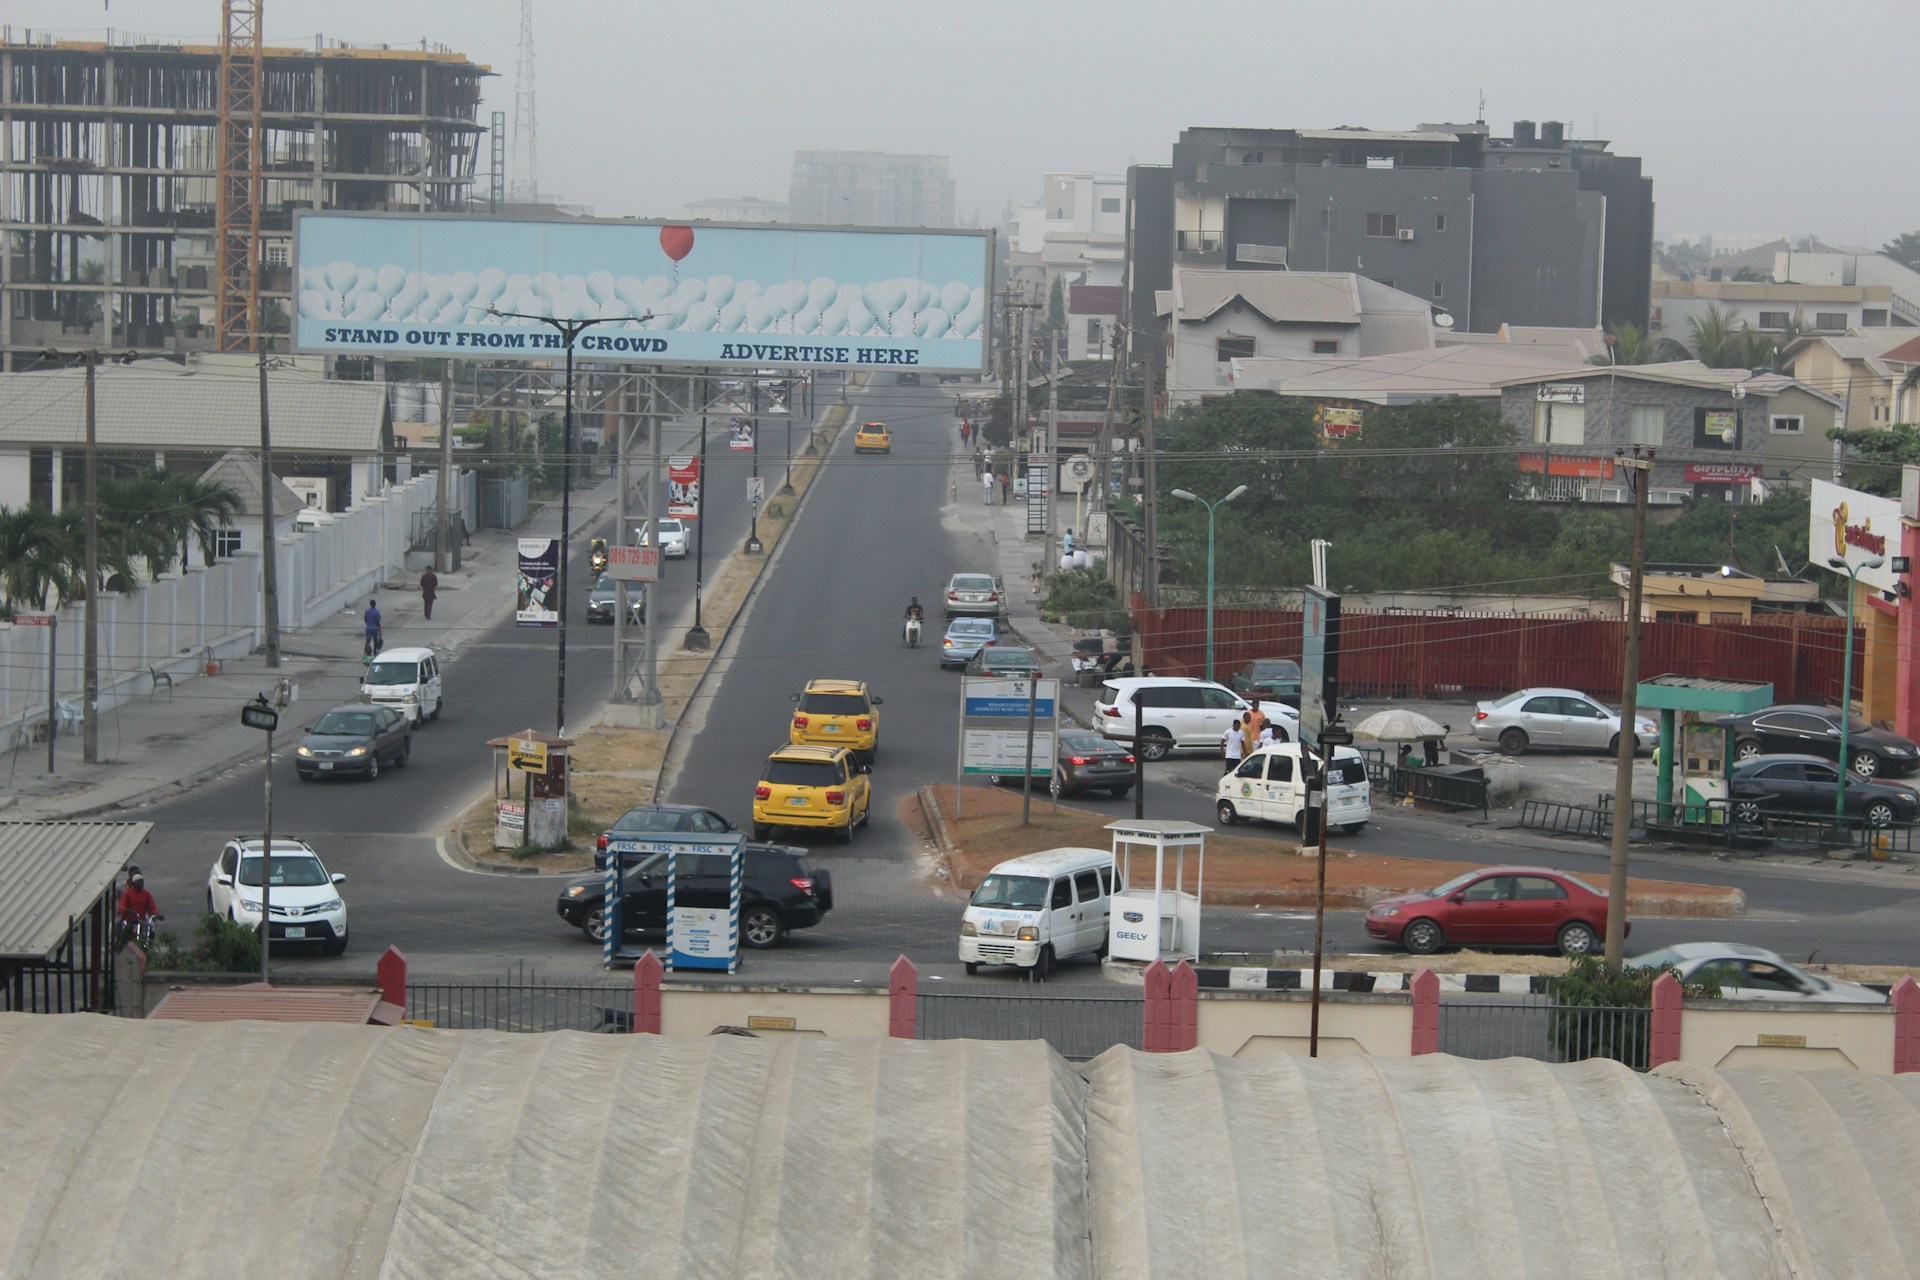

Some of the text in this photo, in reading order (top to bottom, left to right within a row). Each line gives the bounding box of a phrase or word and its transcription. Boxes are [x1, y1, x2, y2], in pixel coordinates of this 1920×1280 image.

[325, 328, 399, 345] STAND
[405, 330, 451, 346] OUT
[456, 332, 525, 348] FROM
[581, 336, 668, 353] CROWD
[720, 343, 919, 365] ADVERTISE HERE
[628, 549, 640, 565] 729
[511, 751, 544, 761] DIVERSION
[617, 843, 637, 851] FRSC
[653, 844, 672, 852] FRSC
[692, 845, 712, 853] FRSC
[1116, 931, 1148, 941] GEELY
